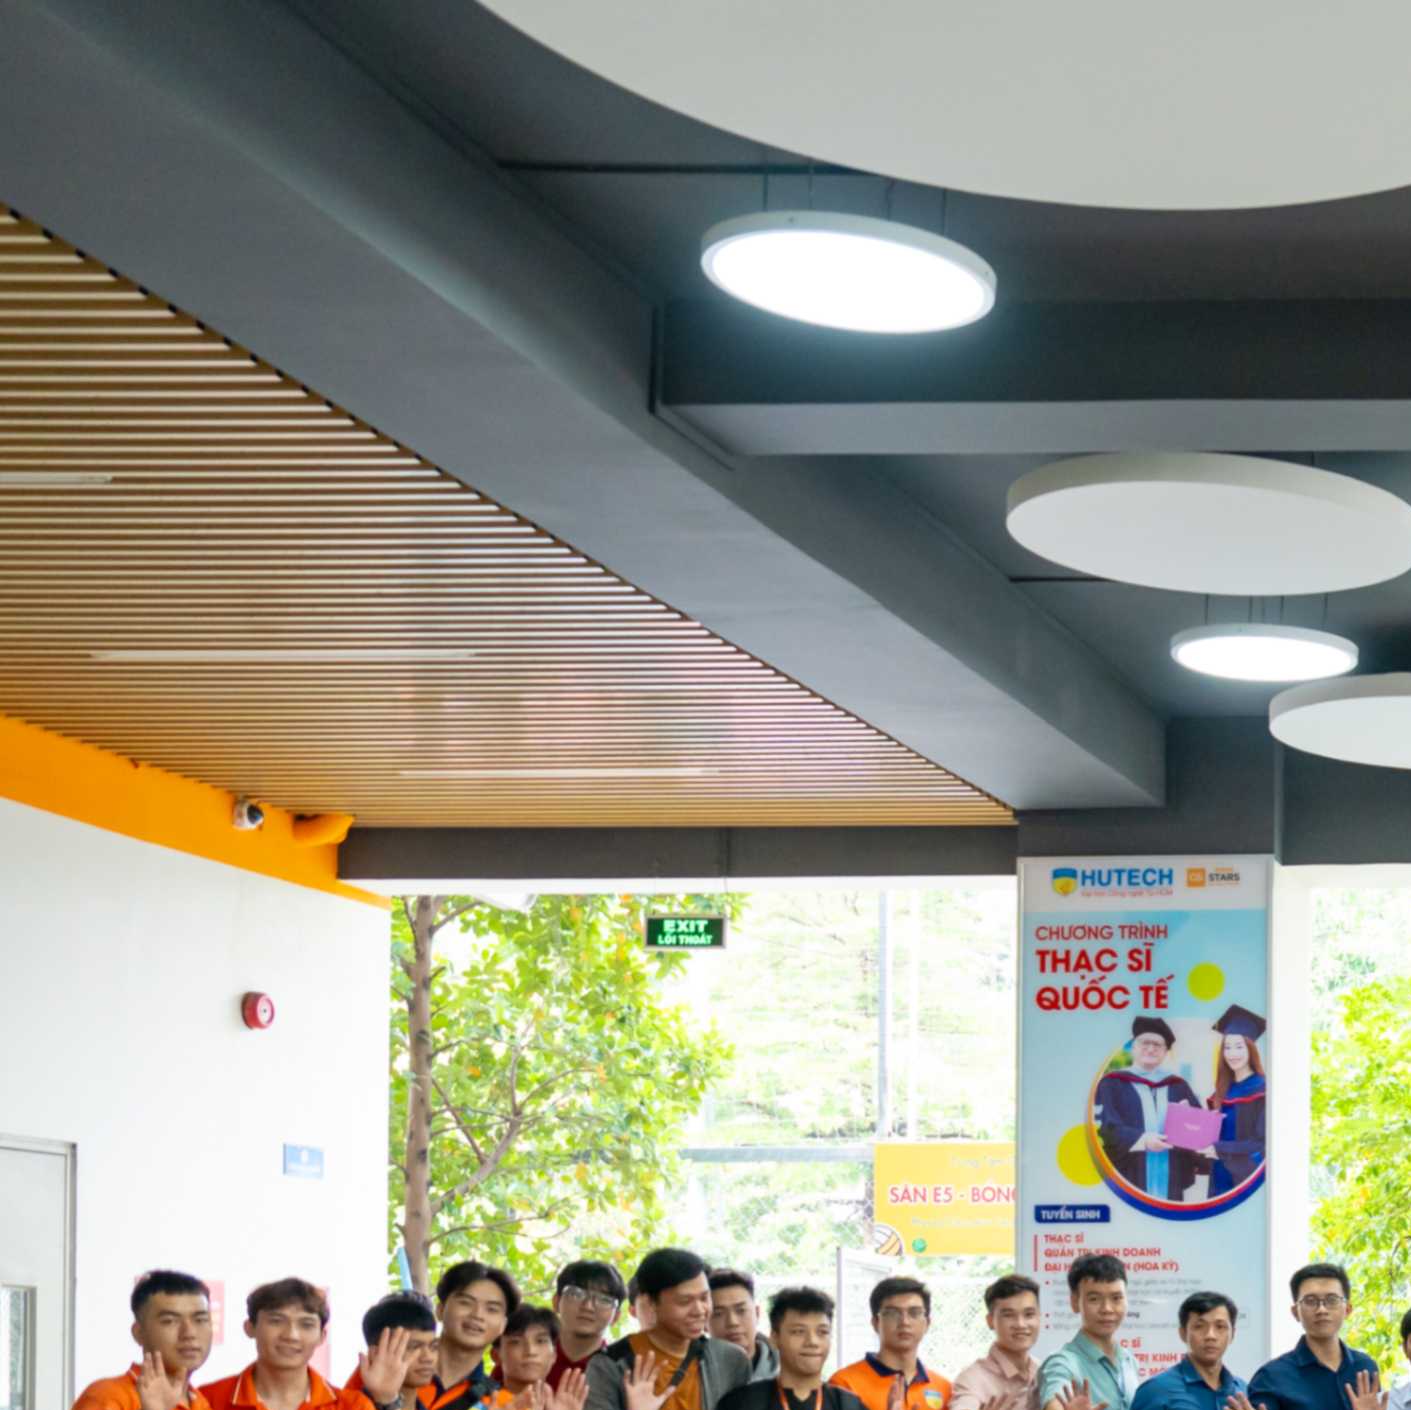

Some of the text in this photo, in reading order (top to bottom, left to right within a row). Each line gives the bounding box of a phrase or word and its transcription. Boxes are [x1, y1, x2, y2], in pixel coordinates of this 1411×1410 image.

[1081, 868, 1173, 887] HUTECH
[1208, 873, 1240, 881] STARS
[663, 920, 708, 932] EXIT
[1035, 921, 1168, 941] CHƯƠNG TRÌNH
[1035, 942, 1155, 980] THẠC SĨ
[1035, 974, 1175, 1011] QUỐC TẾ
[933, 1186, 953, 1203] E5
[1075, 1209, 1101, 1219] SINH
[1123, 1248, 1161, 1257] DOANH
[1152, 1353, 1178, 1363] KINH
